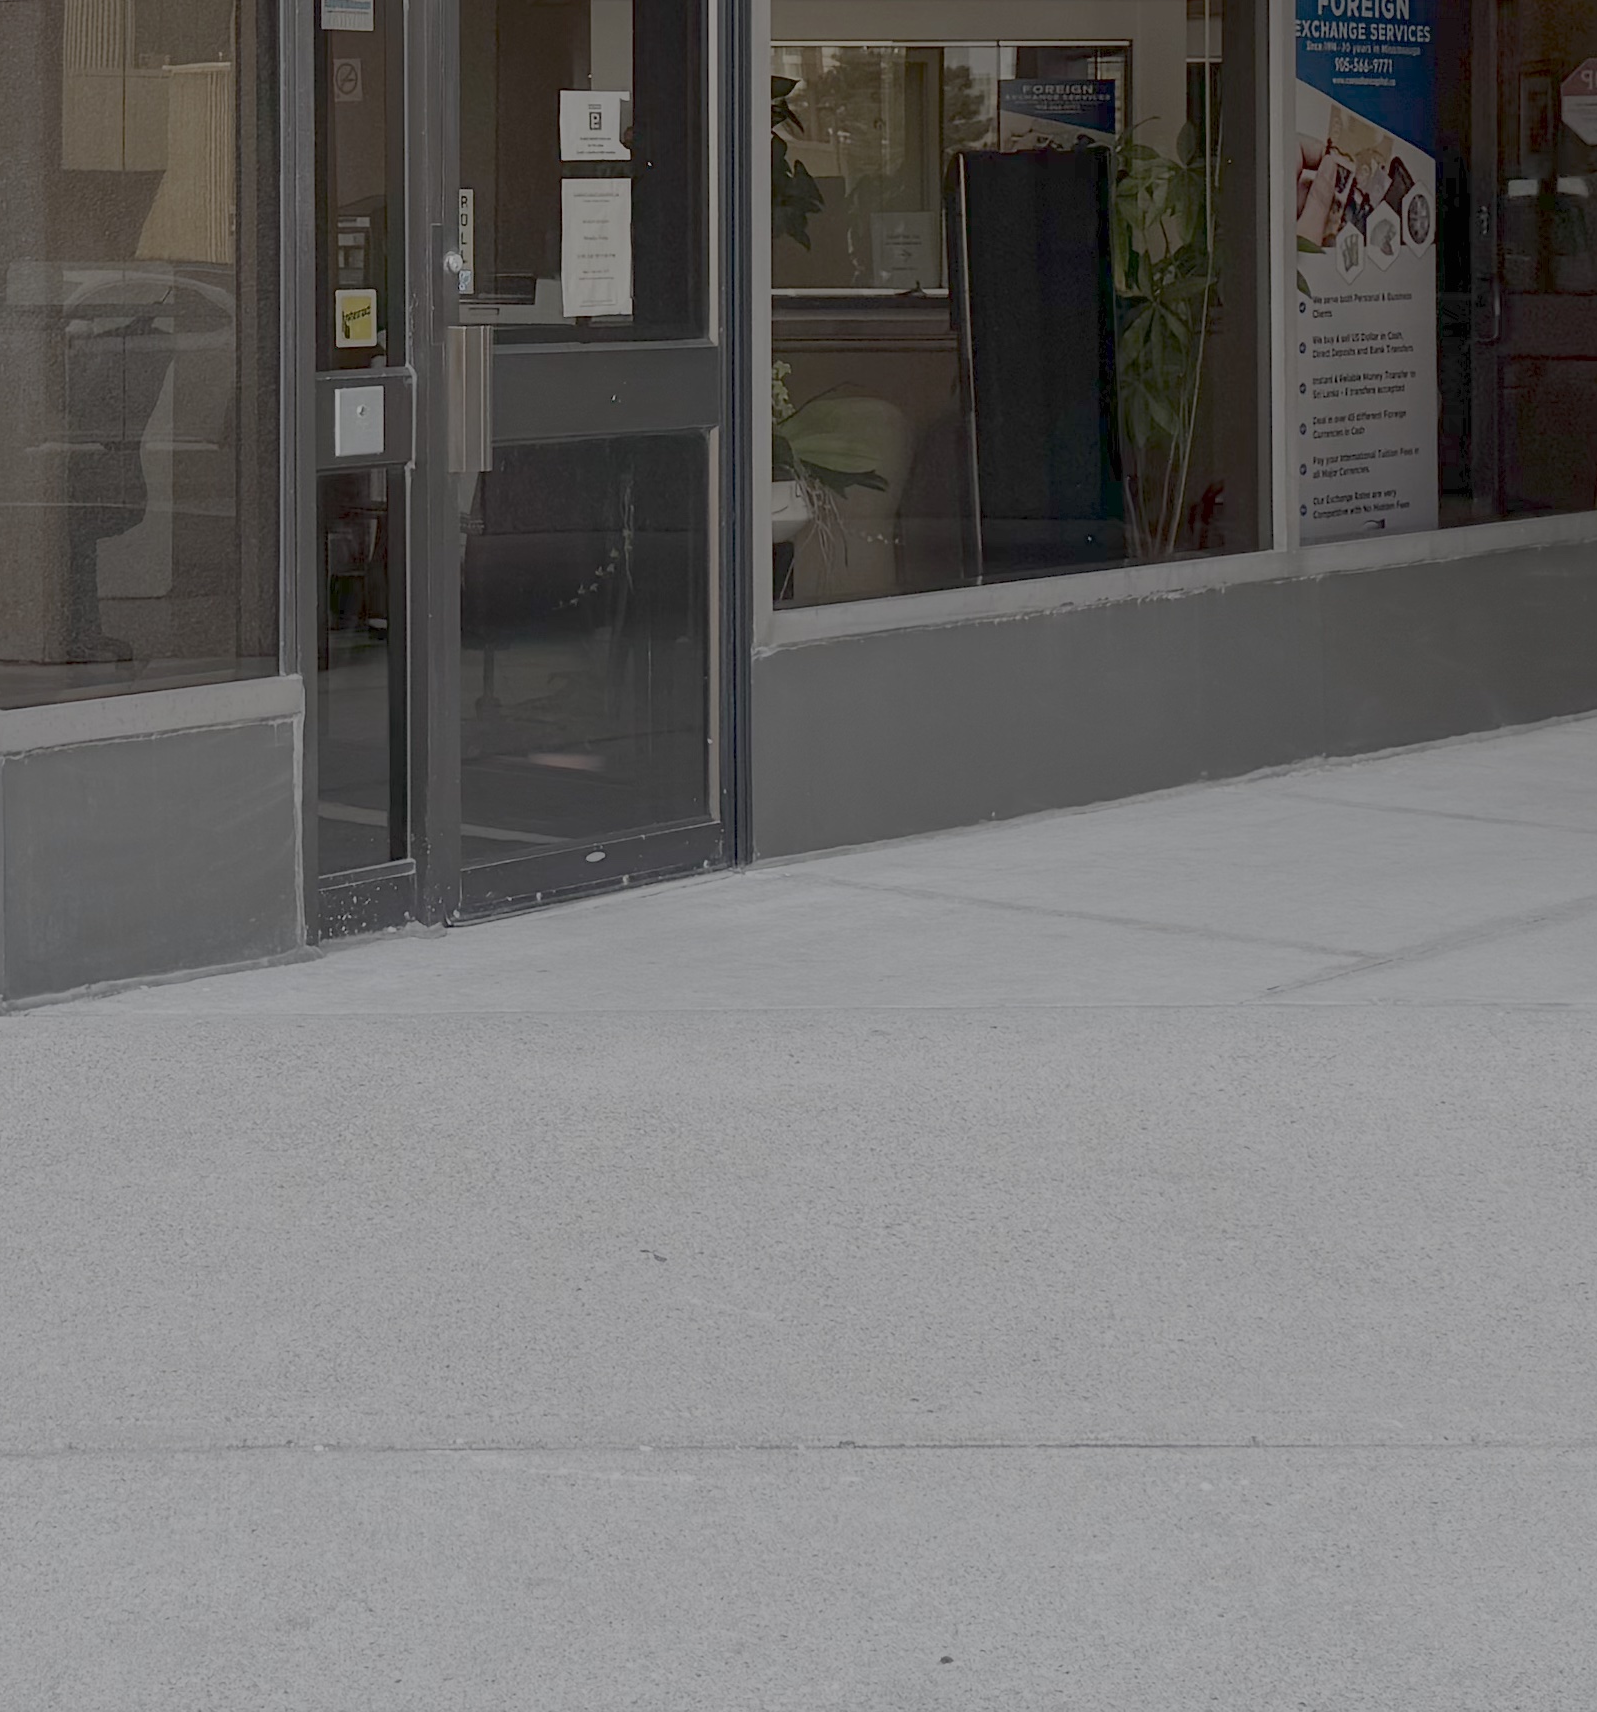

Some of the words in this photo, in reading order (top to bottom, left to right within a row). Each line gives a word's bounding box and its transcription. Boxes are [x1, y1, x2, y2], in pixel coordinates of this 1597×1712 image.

[1294, 19, 1366, 40] EXCHANGE
[1370, 23, 1431, 43] SERVICES
[1022, 84, 1093, 94] FOREIGN
